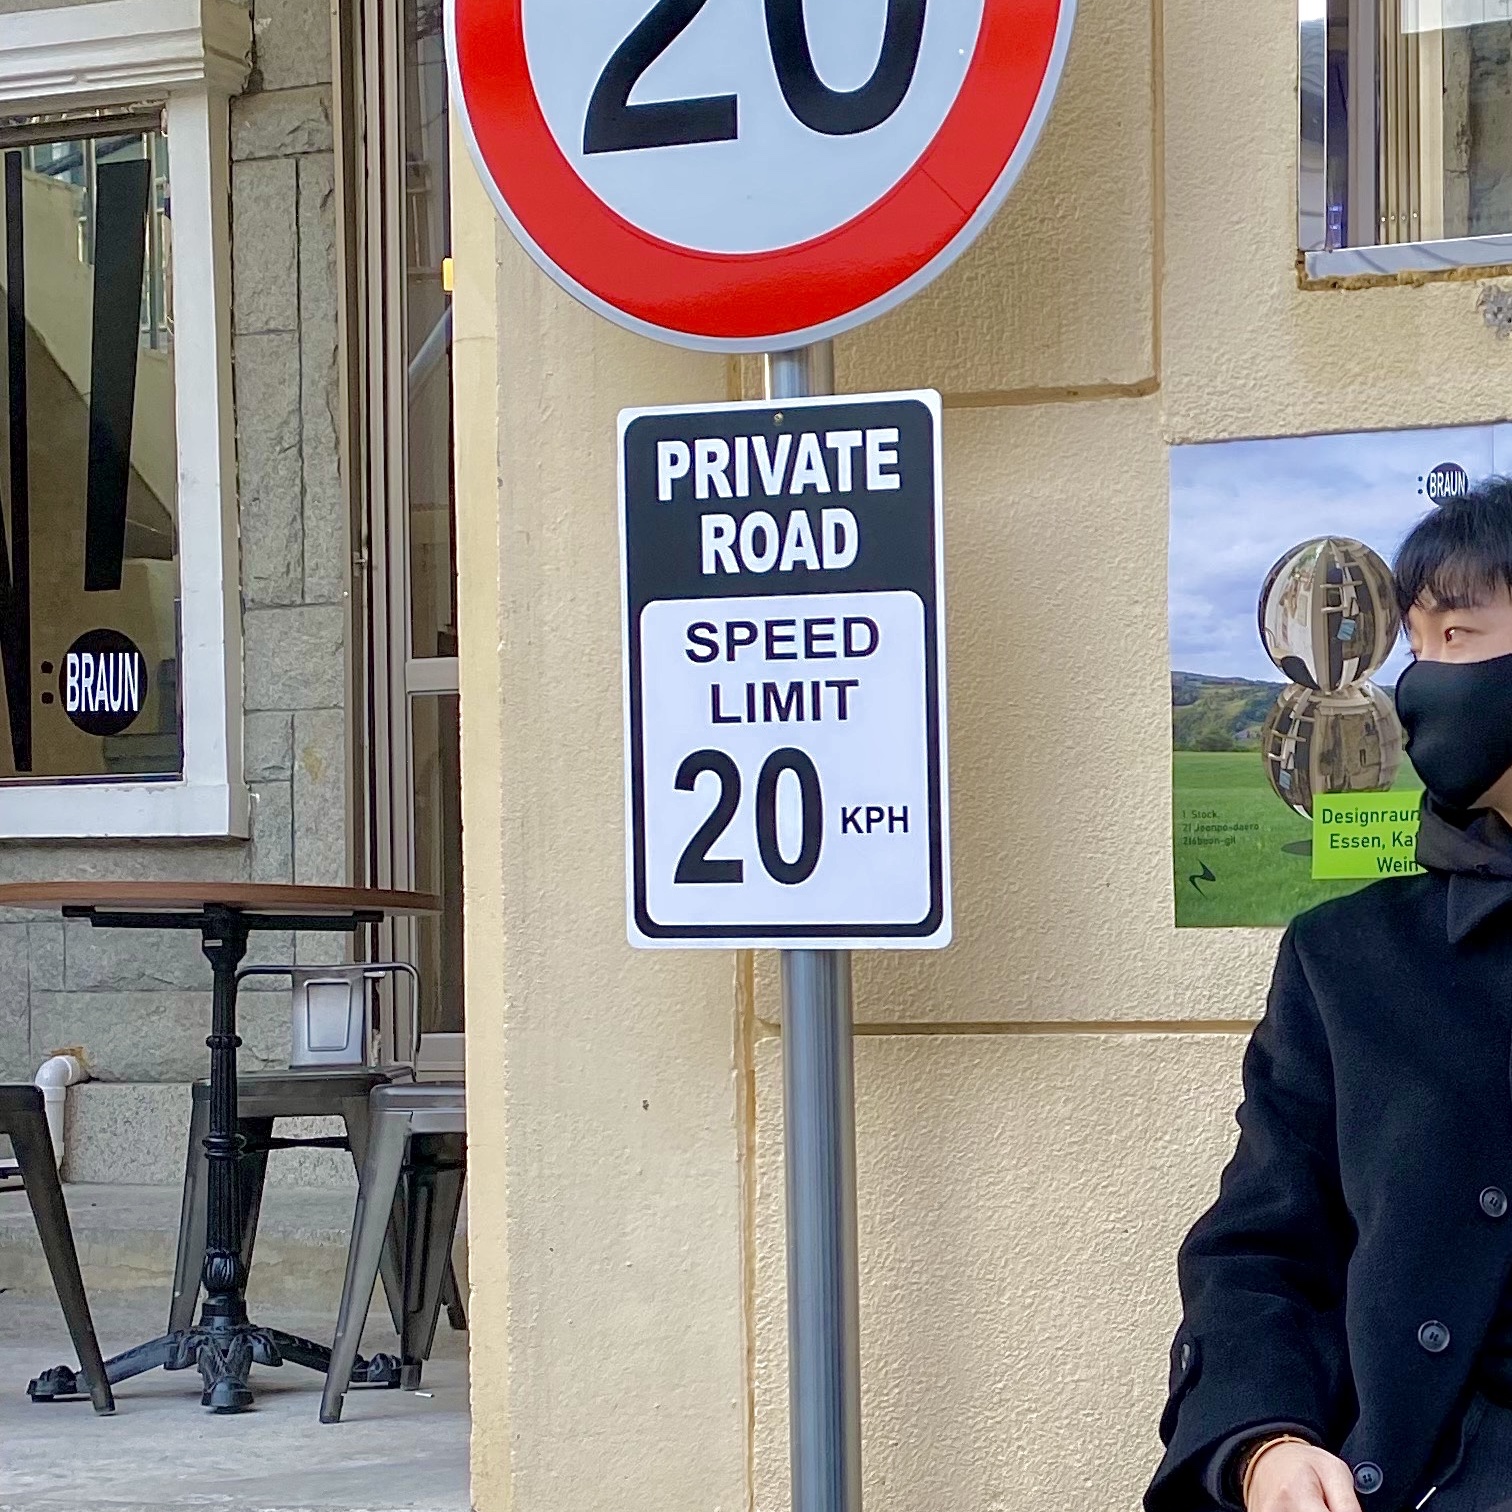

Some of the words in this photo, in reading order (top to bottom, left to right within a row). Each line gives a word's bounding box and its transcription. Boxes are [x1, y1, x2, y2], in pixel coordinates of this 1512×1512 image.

[657, 427, 900, 501] PRIVATE
[700, 507, 859, 575] ROAD
[685, 616, 880, 663] SPEED
[710, 679, 859, 724] LIMIT
[673, 746, 824, 885] 20
[841, 805, 909, 834] KPH
[1330, 833, 1386, 850] Essen,
[1376, 856, 1419, 873] Wein
